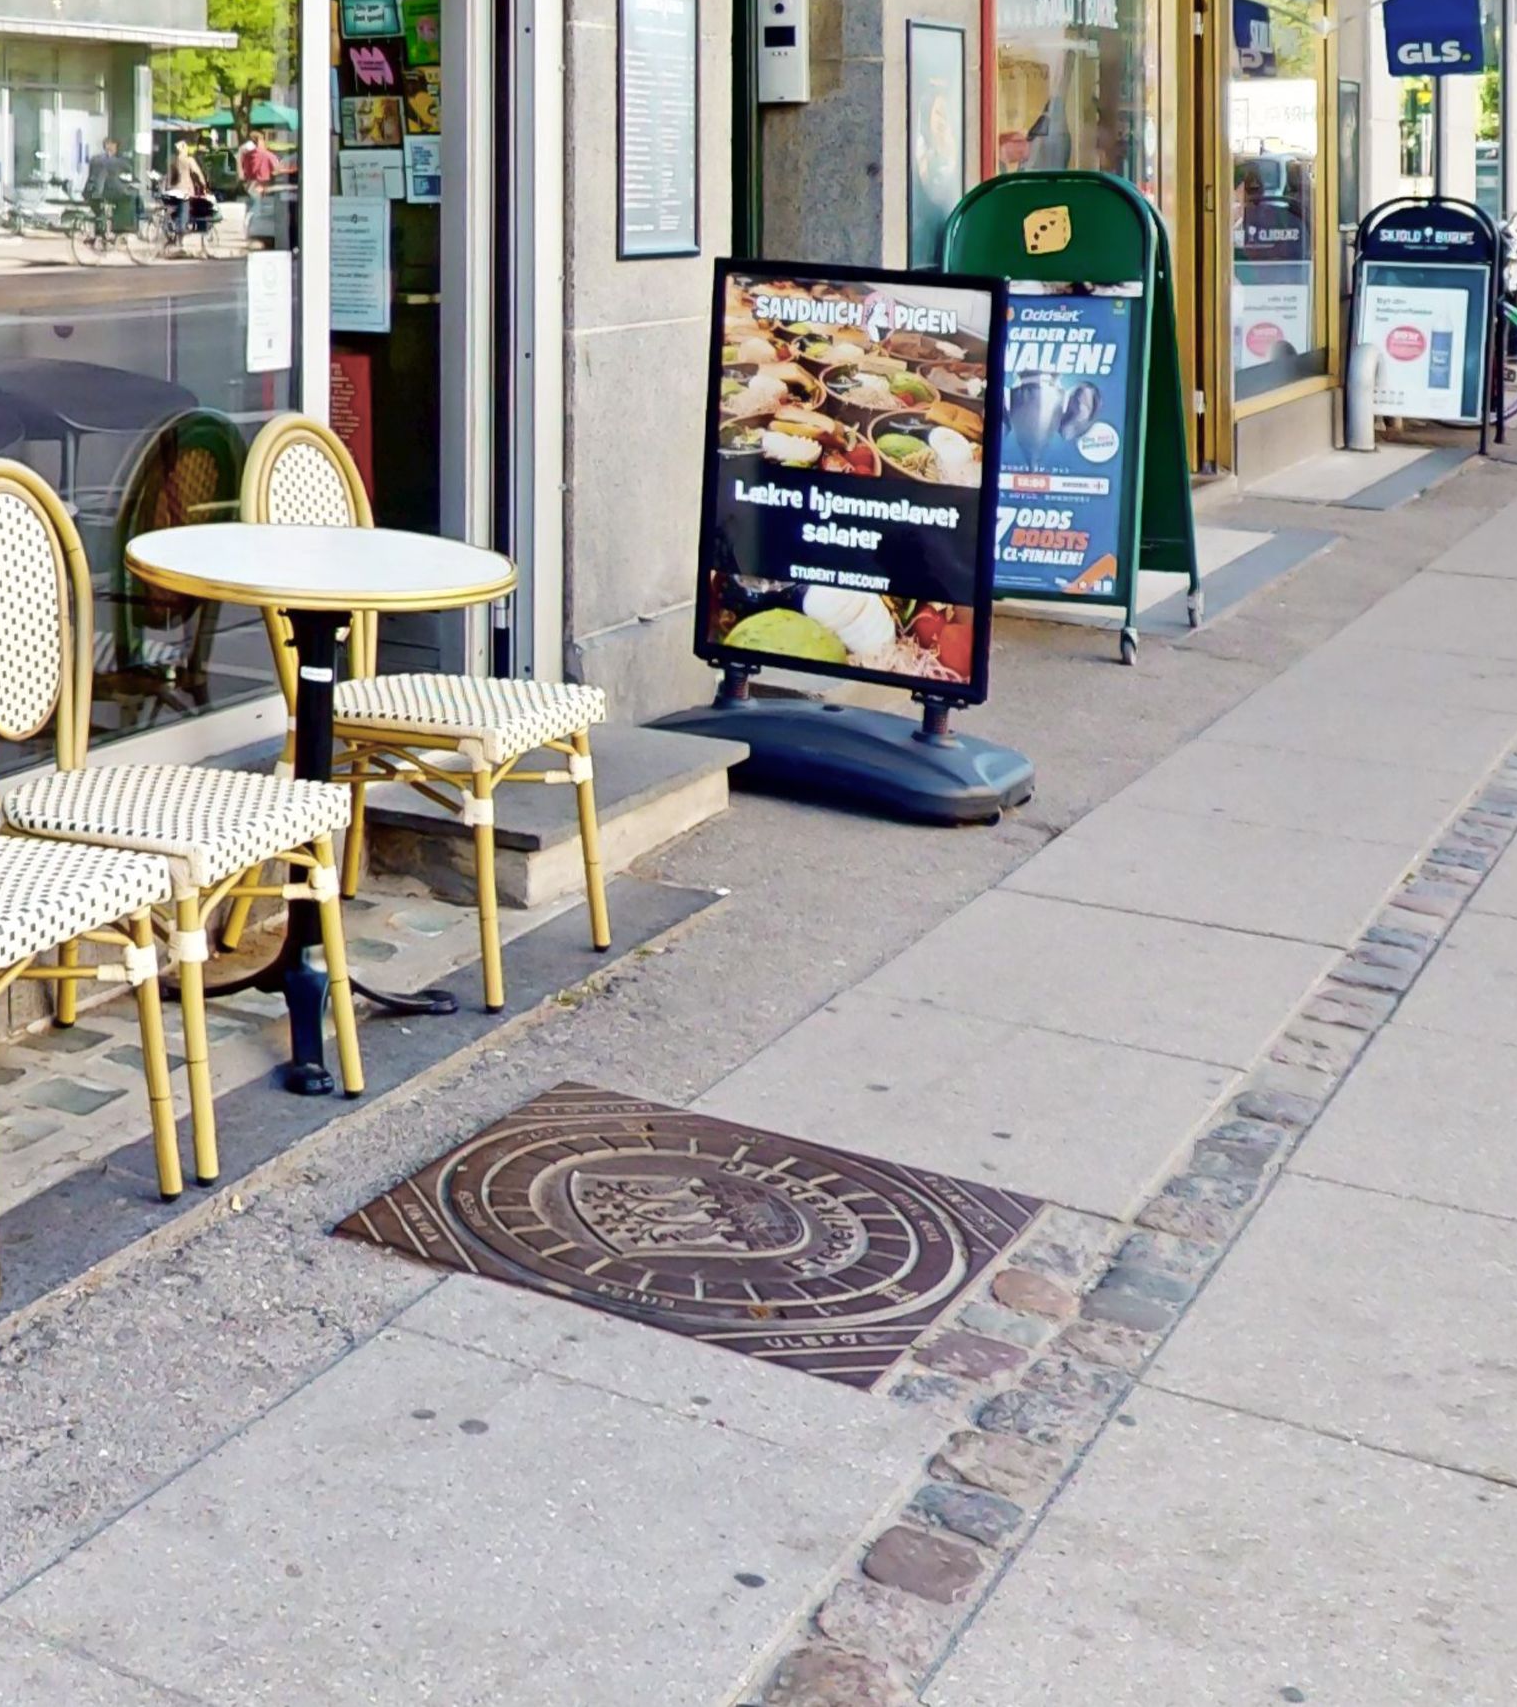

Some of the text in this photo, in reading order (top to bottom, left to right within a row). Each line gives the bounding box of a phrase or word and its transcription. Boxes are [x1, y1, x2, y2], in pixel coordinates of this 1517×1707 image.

[755, 294, 958, 334] SANDWICH PIGEN
[1020, 307, 1080, 322] Oddset
[1067, 328, 1096, 342] DET
[1004, 342, 1117, 375] NALEN!
[734, 478, 960, 528] Lækre hjemmelavet
[1017, 507, 1074, 529] ODDS
[802, 521, 882, 550] salater
[1010, 528, 1090, 551] BOOSTS
[789, 564, 890, 592] STUDENT DISCOUNT
